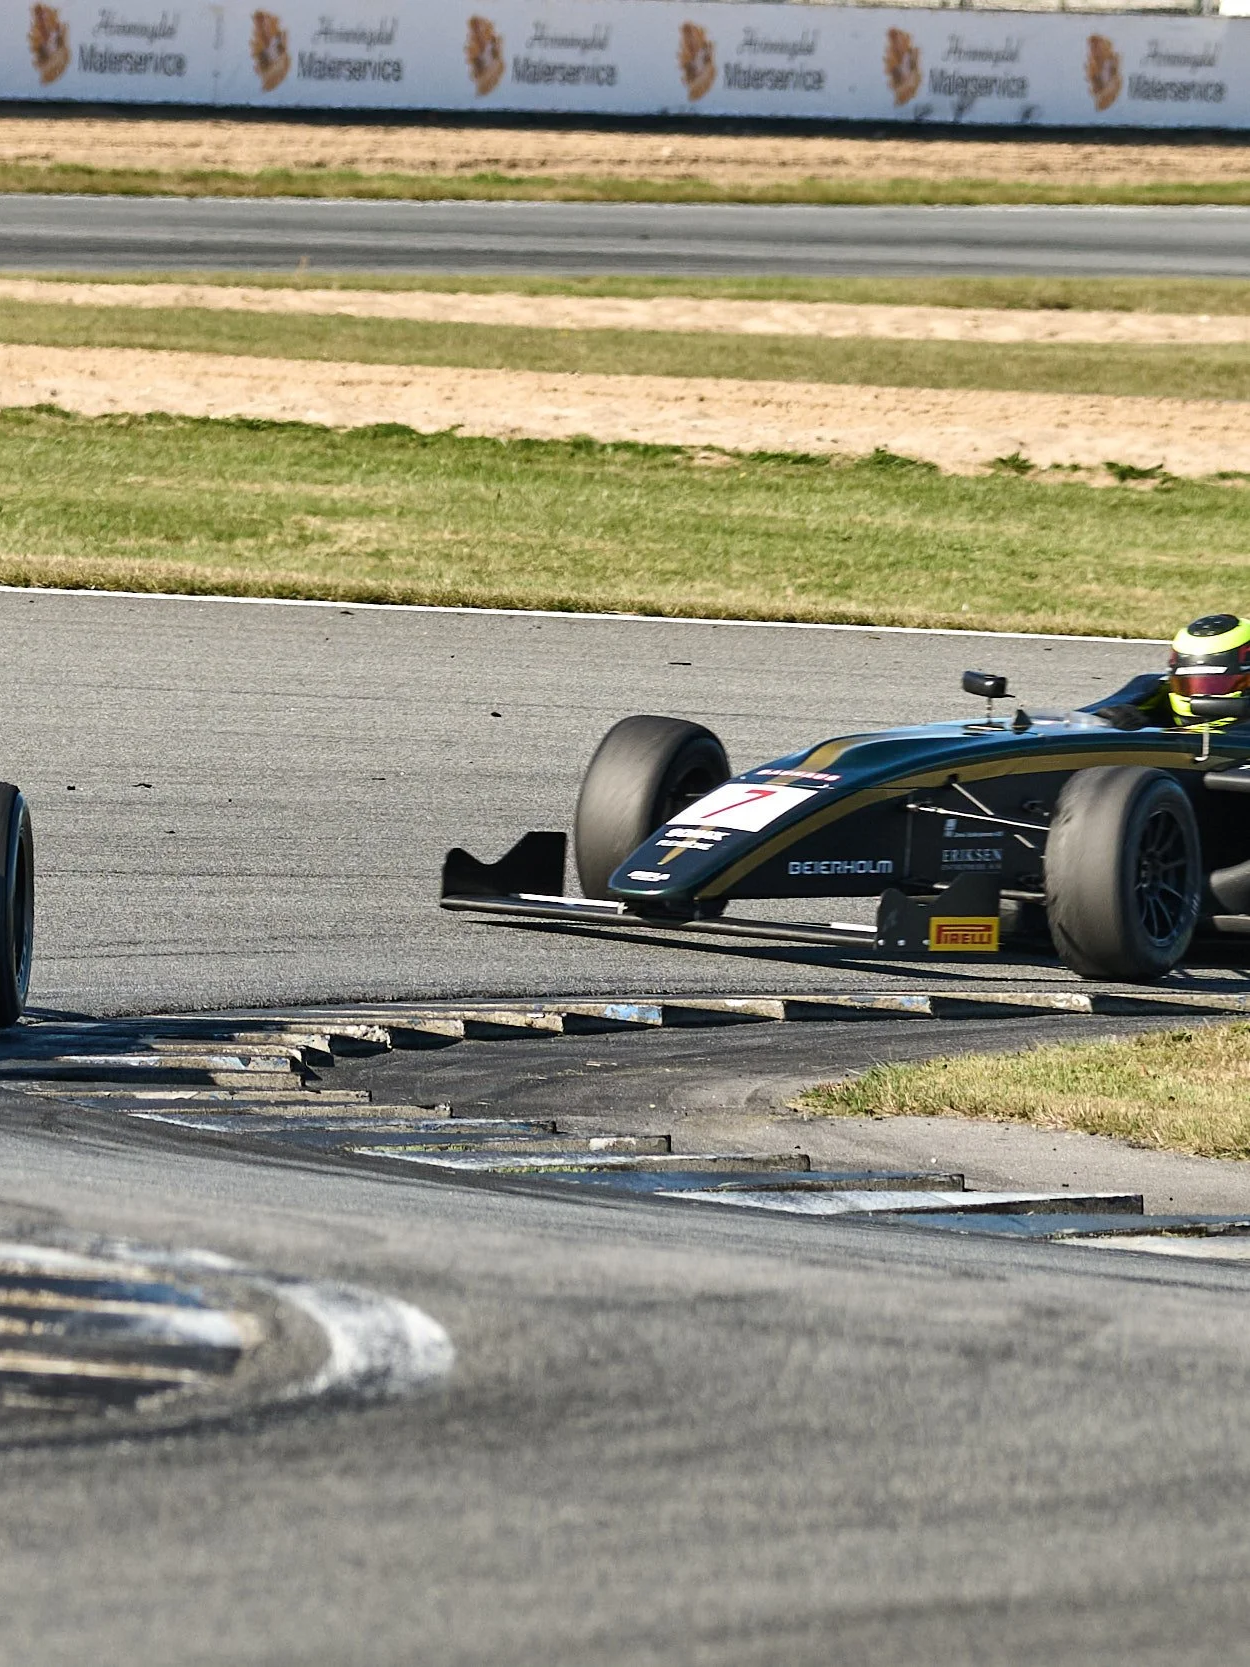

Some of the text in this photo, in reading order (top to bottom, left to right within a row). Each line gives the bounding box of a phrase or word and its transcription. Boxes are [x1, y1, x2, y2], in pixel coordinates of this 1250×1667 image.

[78, 45, 186, 76] Malerservice
[297, 52, 403, 81] Malerservice
[512, 57, 617, 86] Malerservice
[724, 62, 825, 91] Malerservice
[929, 69, 1028, 98] Malerservice
[1127, 75, 1226, 102] Malerservice
[701, 789, 777, 819] 7
[788, 860, 894, 875] BEIERHOLM
[942, 849, 1003, 862] ERIKSEN
[936, 924, 993, 945] PIRELLI
